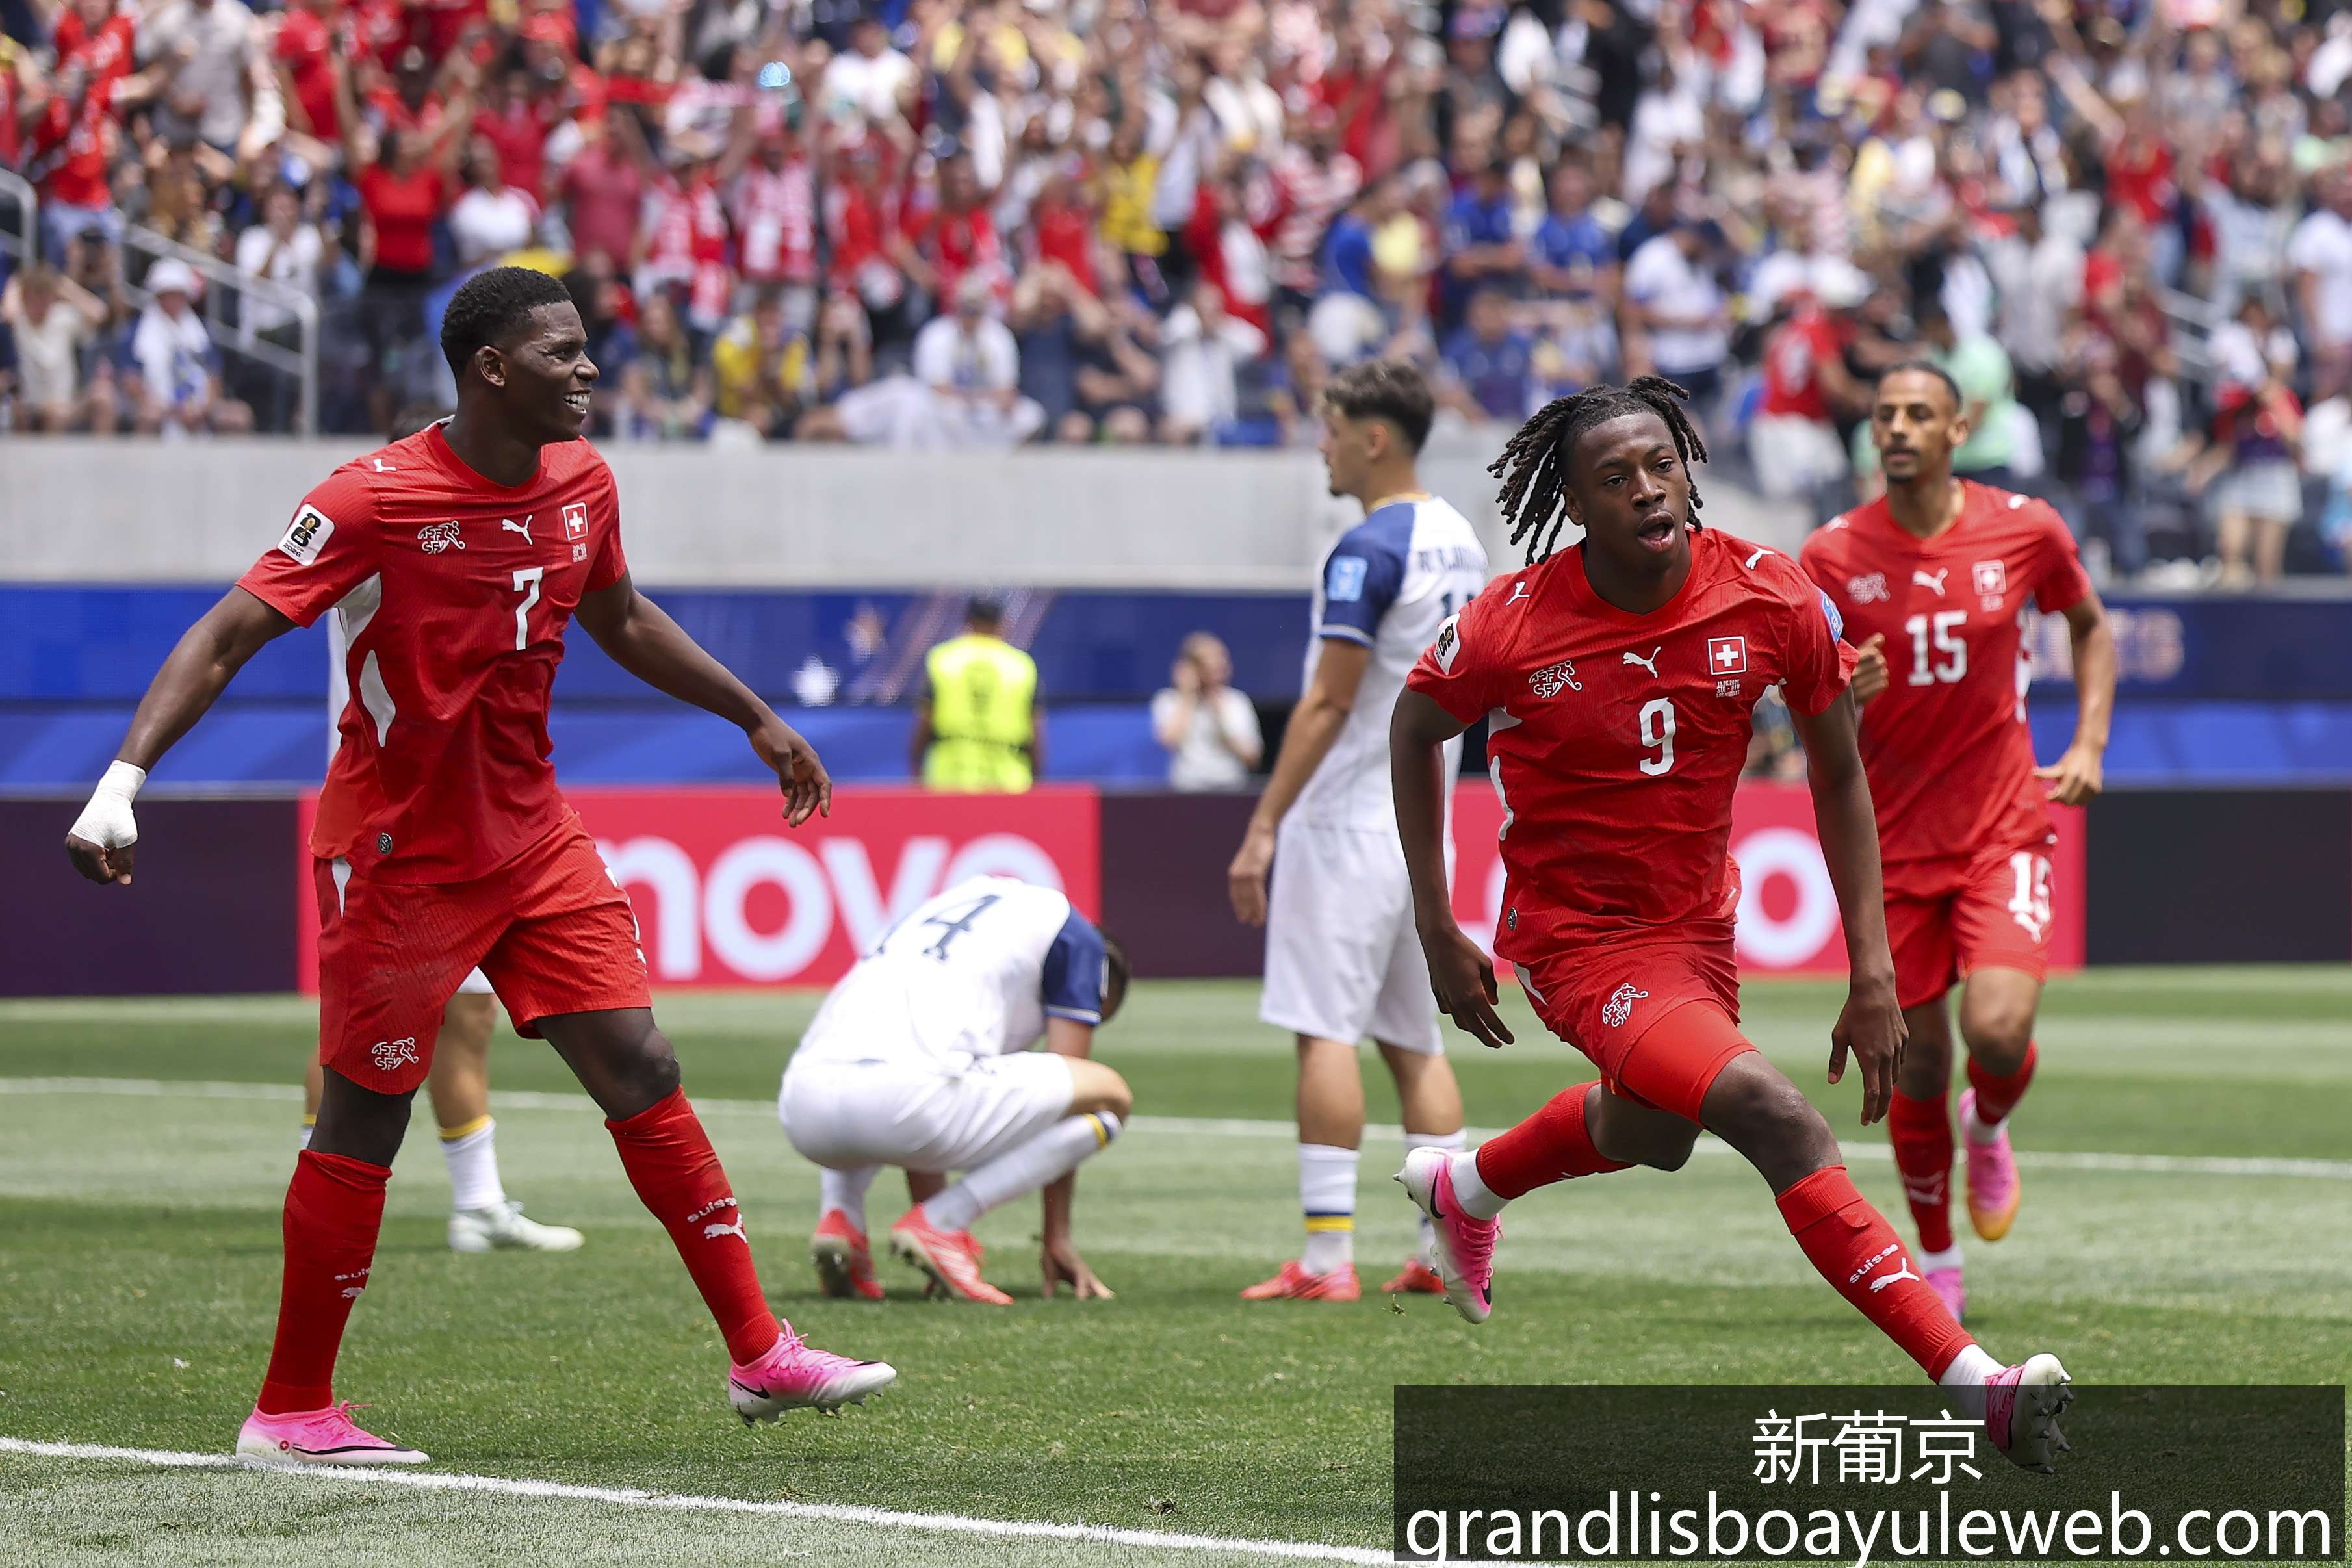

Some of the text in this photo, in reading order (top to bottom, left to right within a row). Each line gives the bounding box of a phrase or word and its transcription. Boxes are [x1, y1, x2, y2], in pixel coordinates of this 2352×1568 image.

[283, 543, 302, 557] 2026
[512, 567, 544, 650] 7
[1905, 610, 1968, 686] 15
[1638, 697, 1676, 776] 9
[2007, 852, 2052, 923] 15
